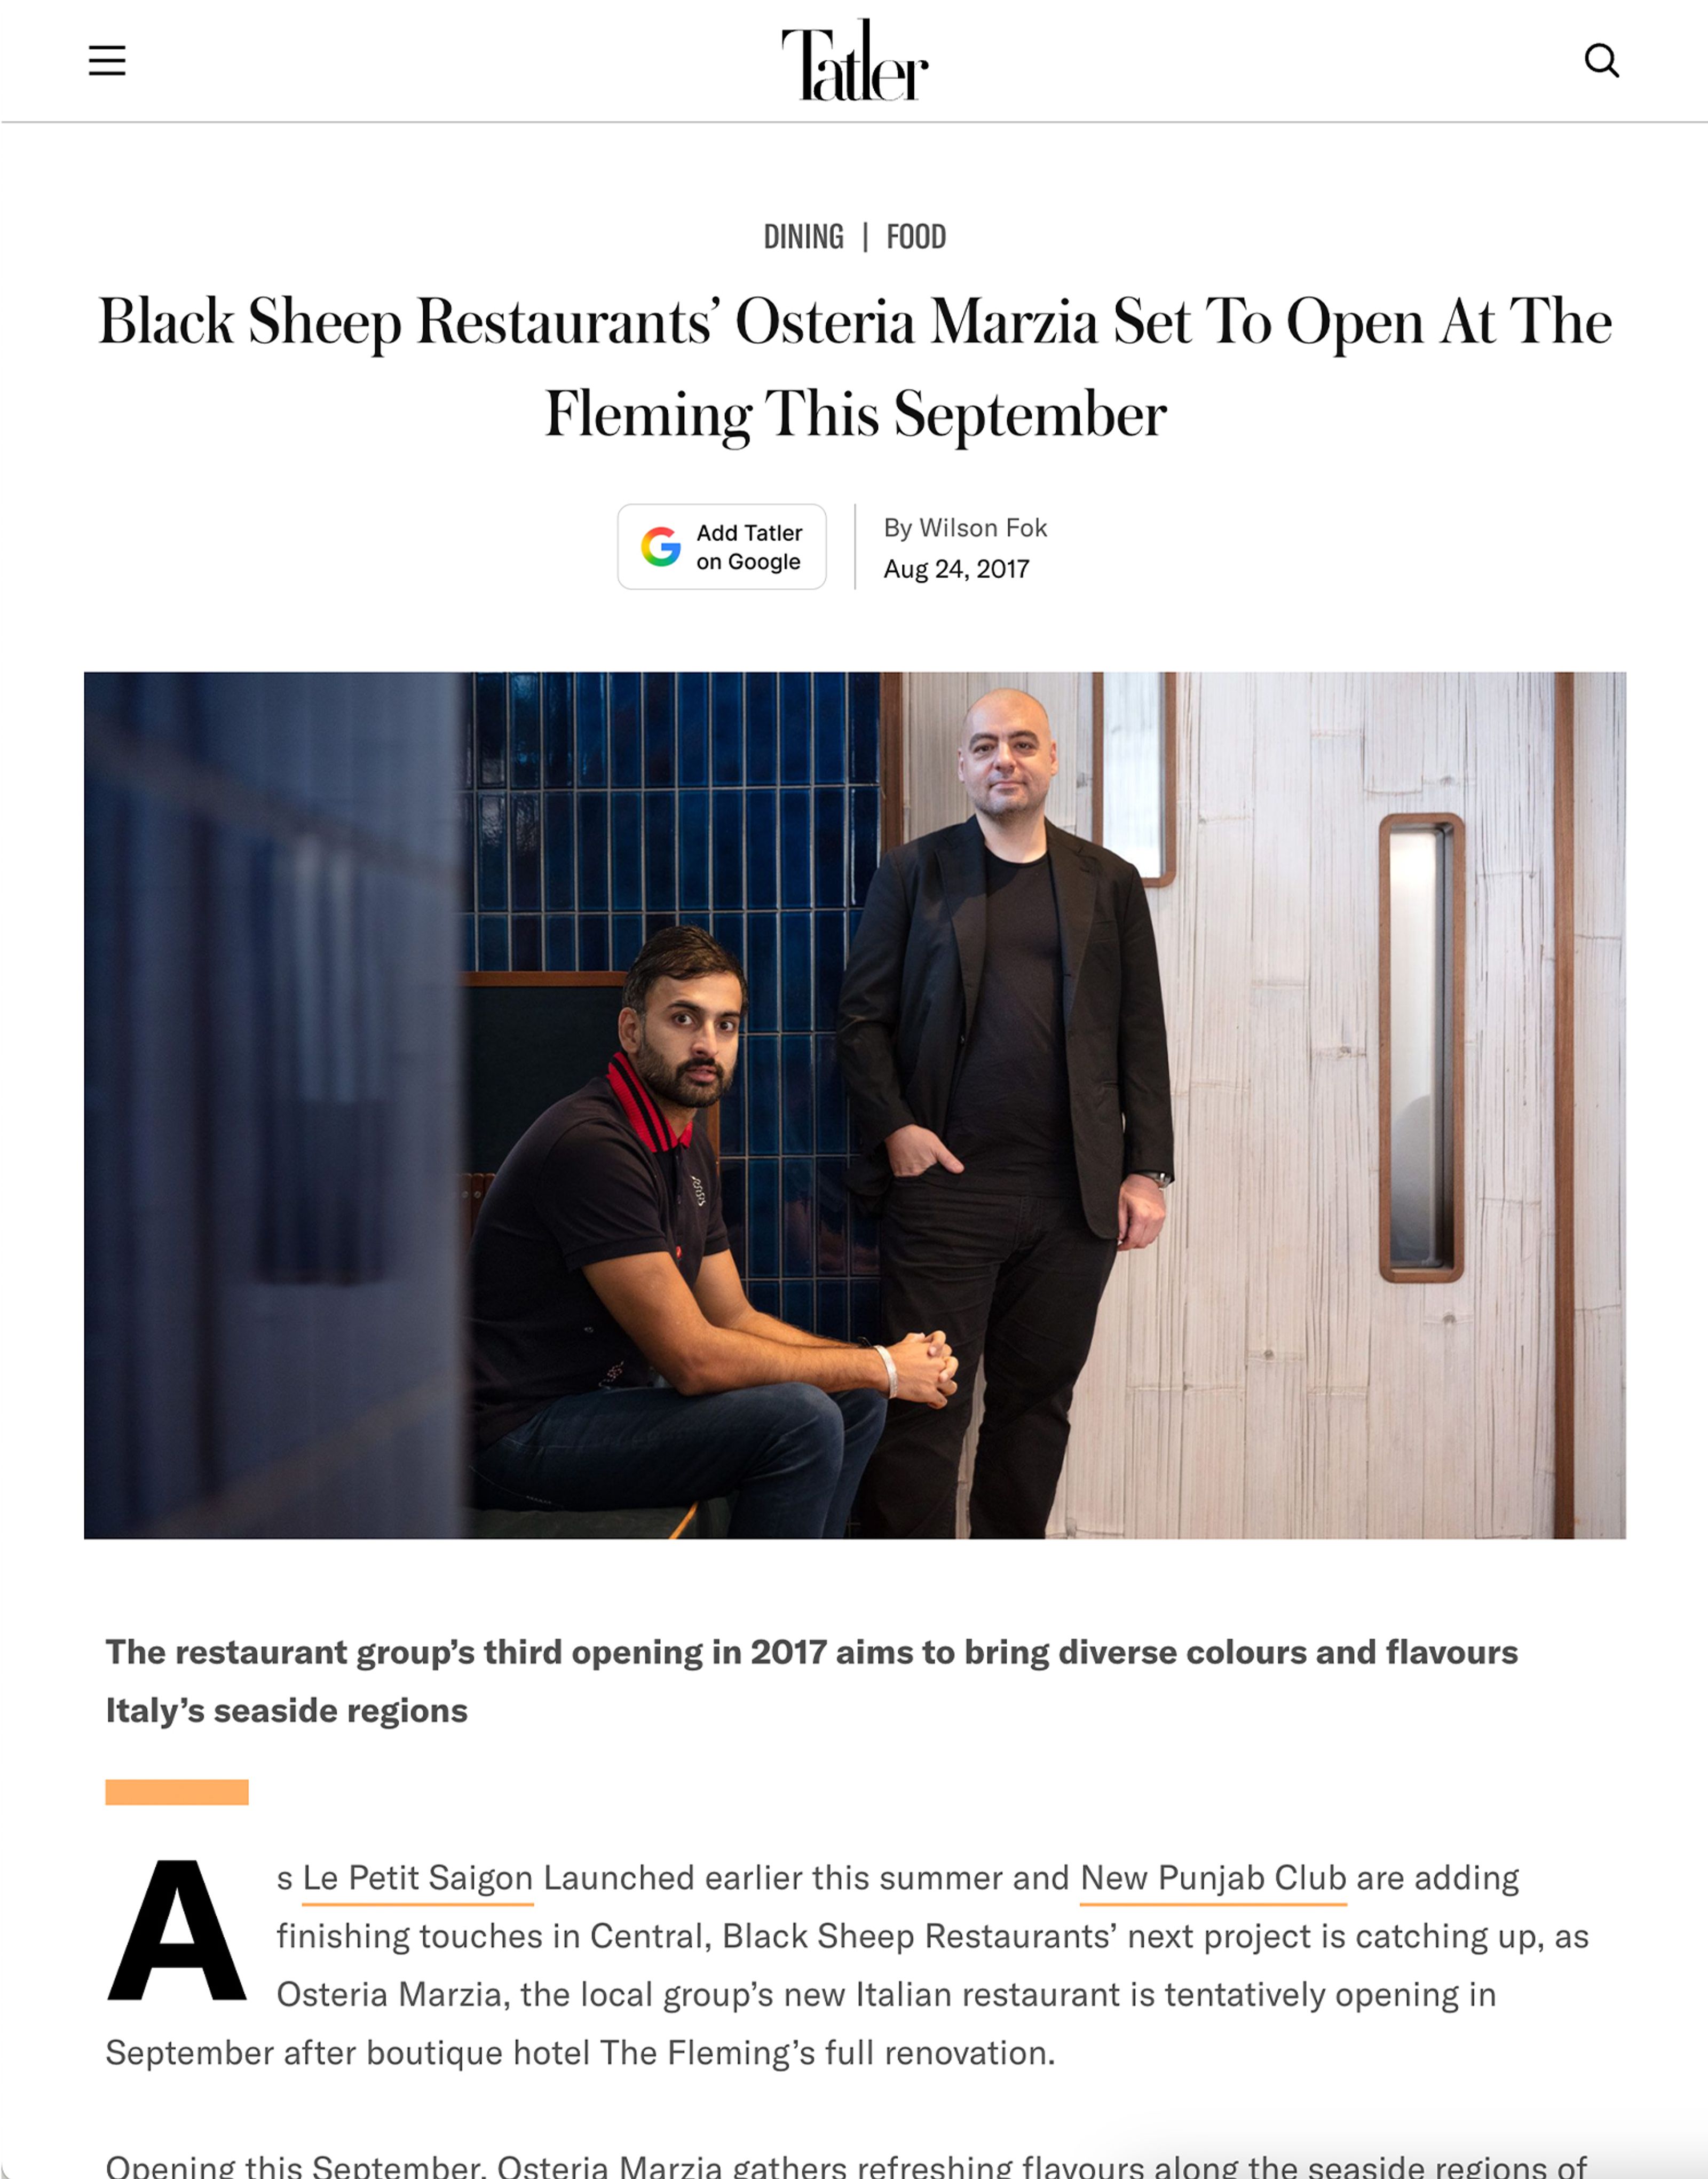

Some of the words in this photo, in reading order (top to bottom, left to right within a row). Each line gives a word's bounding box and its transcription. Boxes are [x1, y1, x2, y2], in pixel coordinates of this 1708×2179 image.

[782, 18, 929, 101] Tatler
[765, 223, 843, 249] DINING
[888, 223, 946, 249] FOOD
[99, 295, 235, 344] Black
[250, 295, 401, 358] Sheep
[417, 296, 720, 344] Restaurants’
[737, 296, 915, 344] Osteria
[931, 297, 1098, 344] Marzia
[1115, 296, 1192, 344] Set
[1206, 297, 1271, 344] To
[1287, 296, 1424, 358] Open
[1439, 297, 1497, 344] At
[1509, 295, 1612, 344] The
[546, 388, 754, 451] Fleming
[765, 388, 879, 437] This
[896, 388, 1168, 451] September
[697, 524, 737, 541] Add
[744, 524, 803, 541] Tatler
[885, 518, 912, 542] By
[920, 517, 997, 537] Wilson
[1007, 517, 1048, 537] Fok
[640, 526, 682, 567] G
[697, 557, 721, 570] on
[729, 552, 801, 574] Google
[883, 559, 929, 583] Aug
[936, 559, 969, 582] 24,
[977, 559, 1030, 579] 2017
[105, 1638, 165, 1664] The
[177, 1640, 347, 1664] restaurant
[357, 1639, 475, 1671] group’s
[484, 1638, 562, 1664] third
[572, 1638, 703, 1671] opening
[713, 1638, 741, 1664] in
[752, 1639, 827, 1664] 2017
[836, 1638, 913, 1664] aims
[922, 1640, 955, 1664] to
[966, 1638, 1050, 1671] bring
[1059, 1638, 1177, 1664] diverse
[1187, 1638, 1307, 1664] colours
[1316, 1638, 1375, 1664] and
[1386, 1638, 1518, 1664] flavours
[107, 1696, 204, 1730] Italy’s
[214, 1696, 337, 1723] seaside
[349, 1697, 468, 1730] regions
[107, 1860, 247, 2001] A
[278, 1872, 292, 1890] s
[305, 1865, 337, 1890] Le
[351, 1865, 419, 1890] Petit
[429, 1864, 532, 1897] Saigon
[545, 1864, 693, 1890] Launched
[706, 1864, 803, 1890] earlier
[812, 1864, 869, 1890] this
[880, 1872, 1003, 1890] summer
[1014, 1864, 1068, 1890] and
[1082, 1865, 1148, 1890] New
[1160, 1864, 1264, 1897] Punjab
[1276, 1864, 1346, 1890] Club
[1357, 1872, 1404, 1890] are
[1416, 1864, 1520, 1897] adding
[276, 1922, 410, 1955] finishing
[419, 1922, 542, 1948] touches
[555, 1923, 579, 1948] in
[591, 1922, 711, 1952] Central,
[724, 1922, 808, 1948] Black
[818, 1922, 914, 1955] Sheep
[927, 1923, 1116, 1948] Restaurants’
[1129, 1925, 1193, 1948] next
[1206, 1923, 1311, 1955] project
[1323, 1923, 1345, 1948] is
[1356, 1922, 1489, 1955] catching
[1499, 1930, 1544, 1955] up,
[1555, 1930, 1588, 1948] as
[278, 1980, 386, 2007] Osteria
[400, 1981, 509, 2011] Marzia,
[520, 1980, 570, 2007] the
[582, 1980, 651, 2007] local
[663, 1981, 773, 2014] group’s
[786, 1988, 845, 2007] new
[858, 1980, 951, 2007] Italian
[964, 1983, 1120, 2007] restaurant
[1132, 1981, 1155, 2007] is
[1165, 1980, 1326, 2013] tentatively
[1336, 1981, 1459, 2014] opening
[1470, 1981, 1495, 2007] in
[106, 2039, 274, 2072] September
[284, 2039, 357, 2065] after
[368, 2039, 502, 2072] boutique
[515, 2039, 588, 2065] hotel
[600, 2039, 657, 2065] The
[669, 2039, 815, 2072] Fleming’s
[825, 2039, 872, 2065] full
[887, 2040, 1054, 2065] renovation.
[245, 2156, 302, 2179] this
[313, 2156, 486, 2179] September
[498, 2156, 607, 2179] Osteria
[621, 2156, 721, 2179] Marzia
[1022, 2156, 1144, 2179] flavours
[1248, 2156, 1298, 2179] the
[1309, 2156, 1425, 2179] seaside
[1558, 2156, 1588, 2179] of
